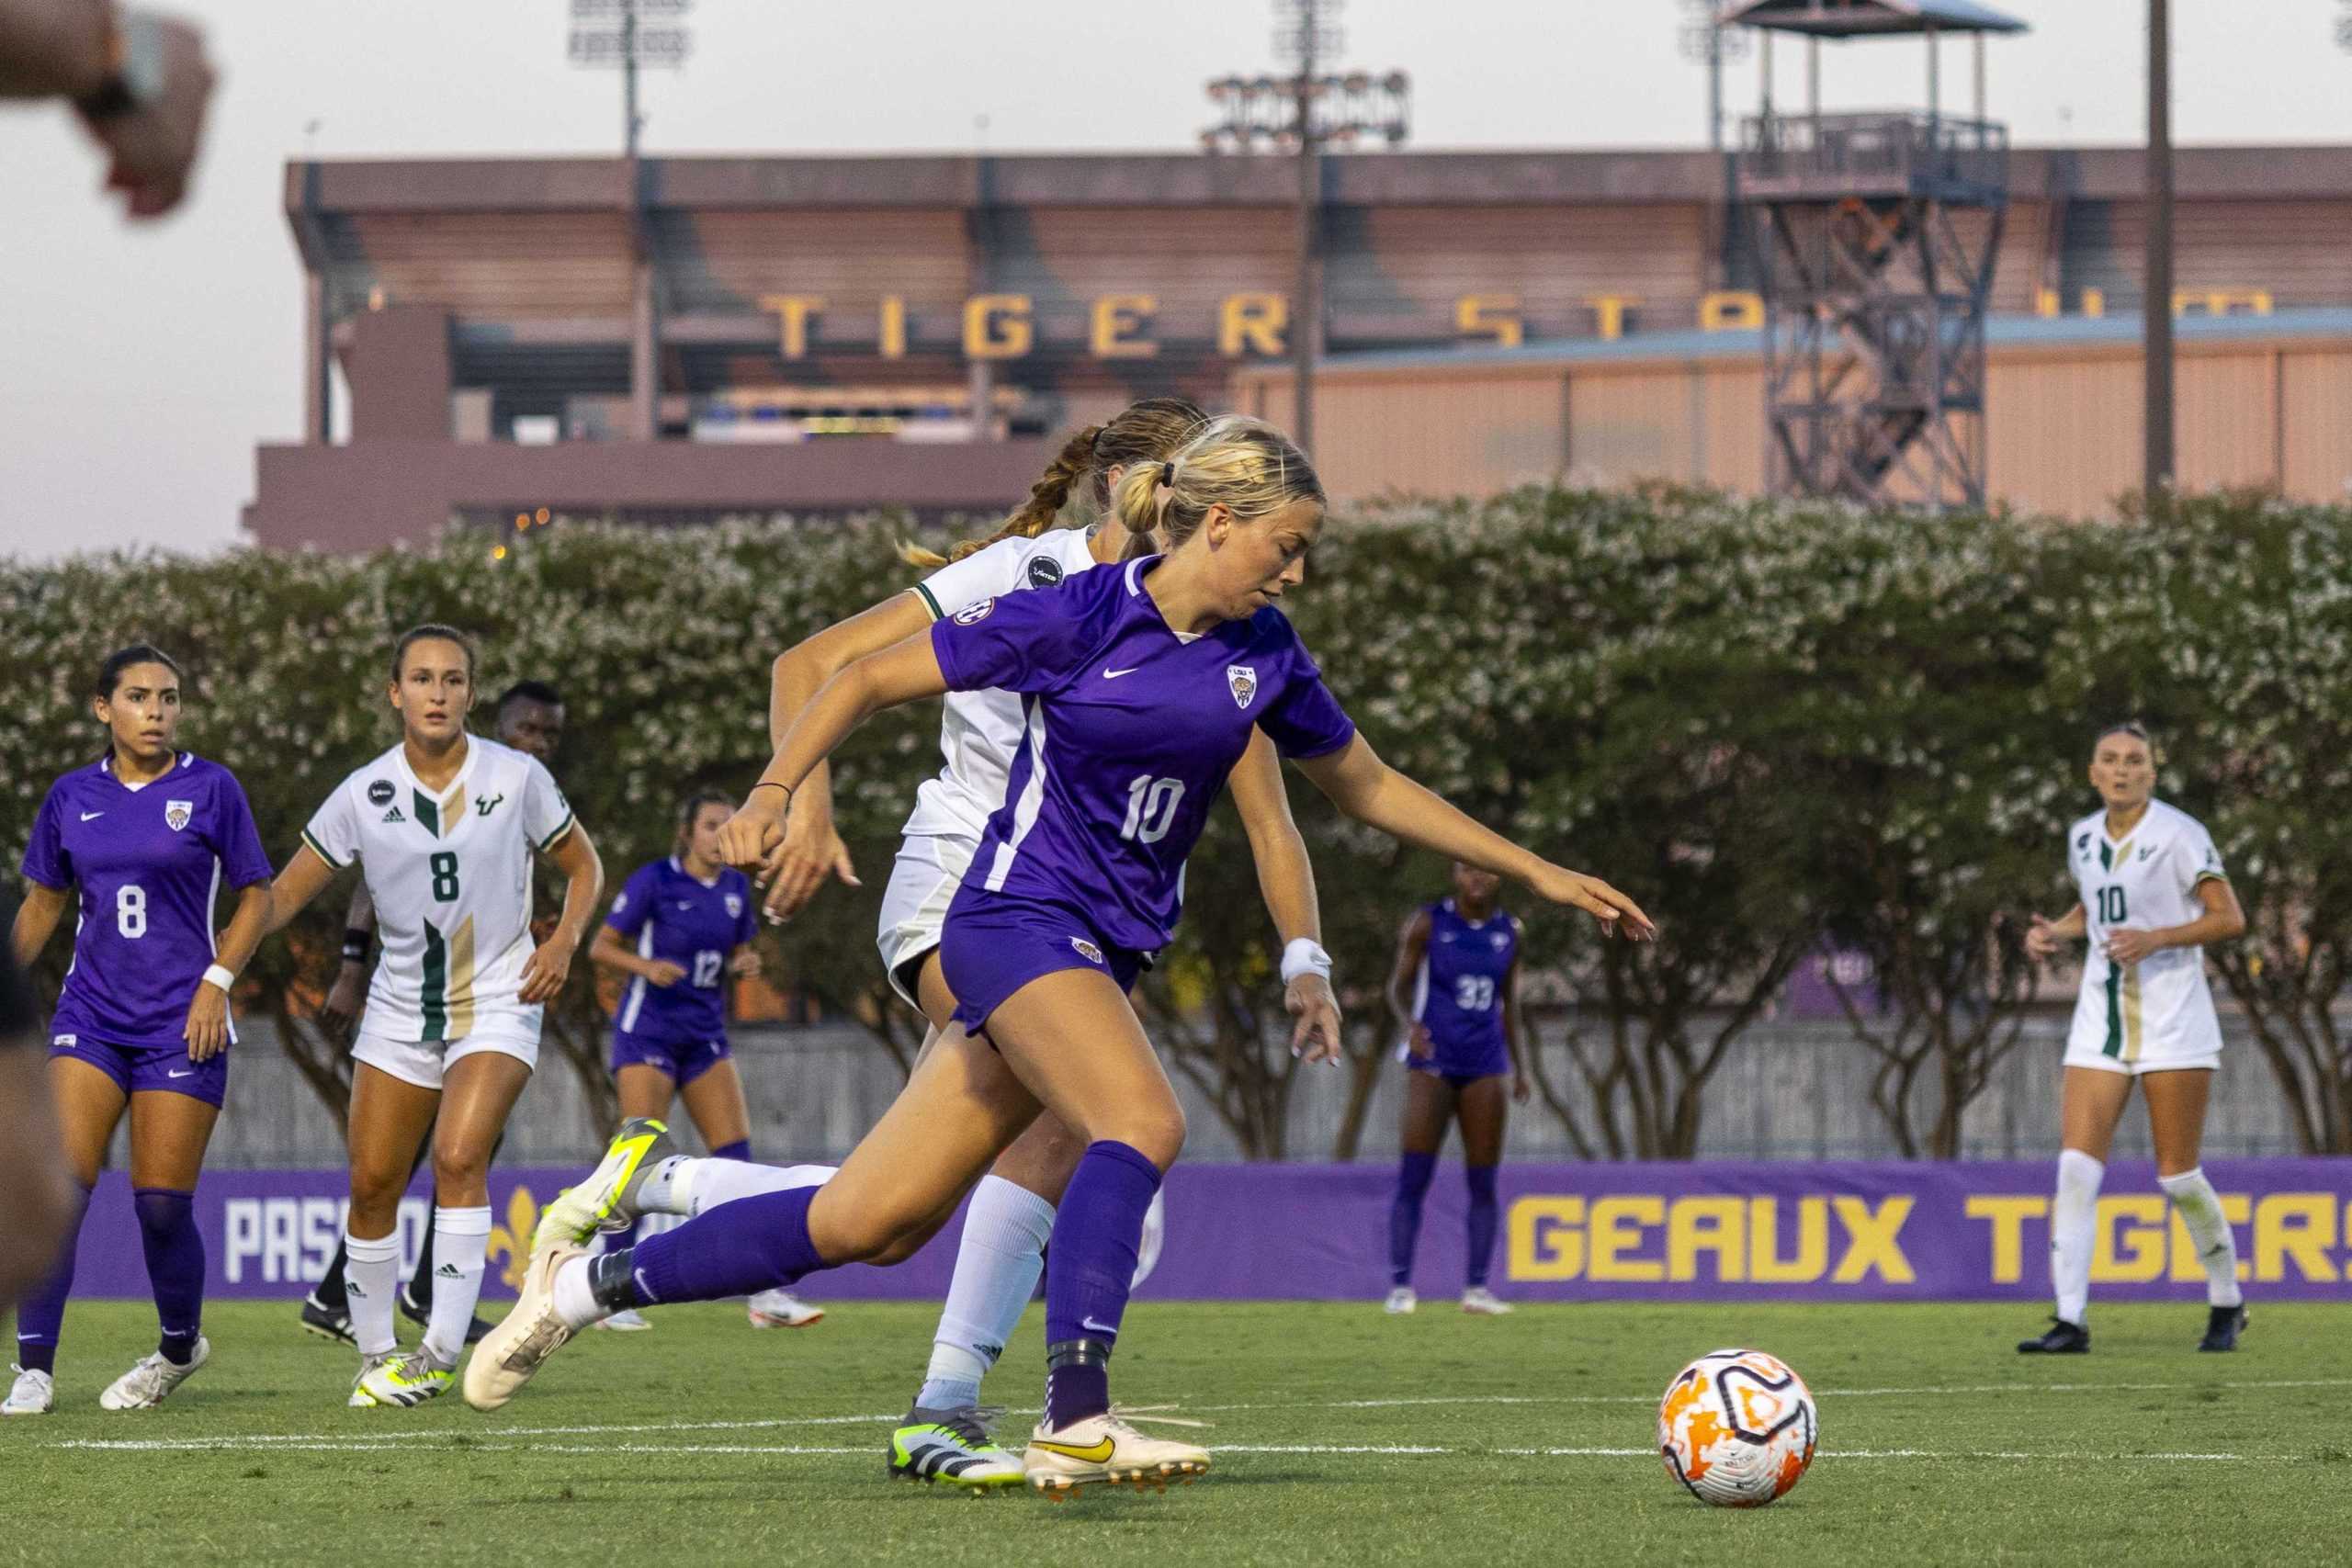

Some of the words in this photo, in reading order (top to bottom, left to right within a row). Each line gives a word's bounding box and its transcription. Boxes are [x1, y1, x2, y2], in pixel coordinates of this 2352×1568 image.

[758, 292, 1287, 359] TIGER
[1119, 774, 1186, 844] 10
[429, 852, 459, 903] 8
[117, 885, 147, 939] 8
[2097, 886, 2127, 924] 10
[692, 949, 723, 988] 12
[1454, 974, 1495, 1012] 33
[1506, 1195, 1917, 1283] GEAUX
[1964, 1193, 2352, 1283] TGER
